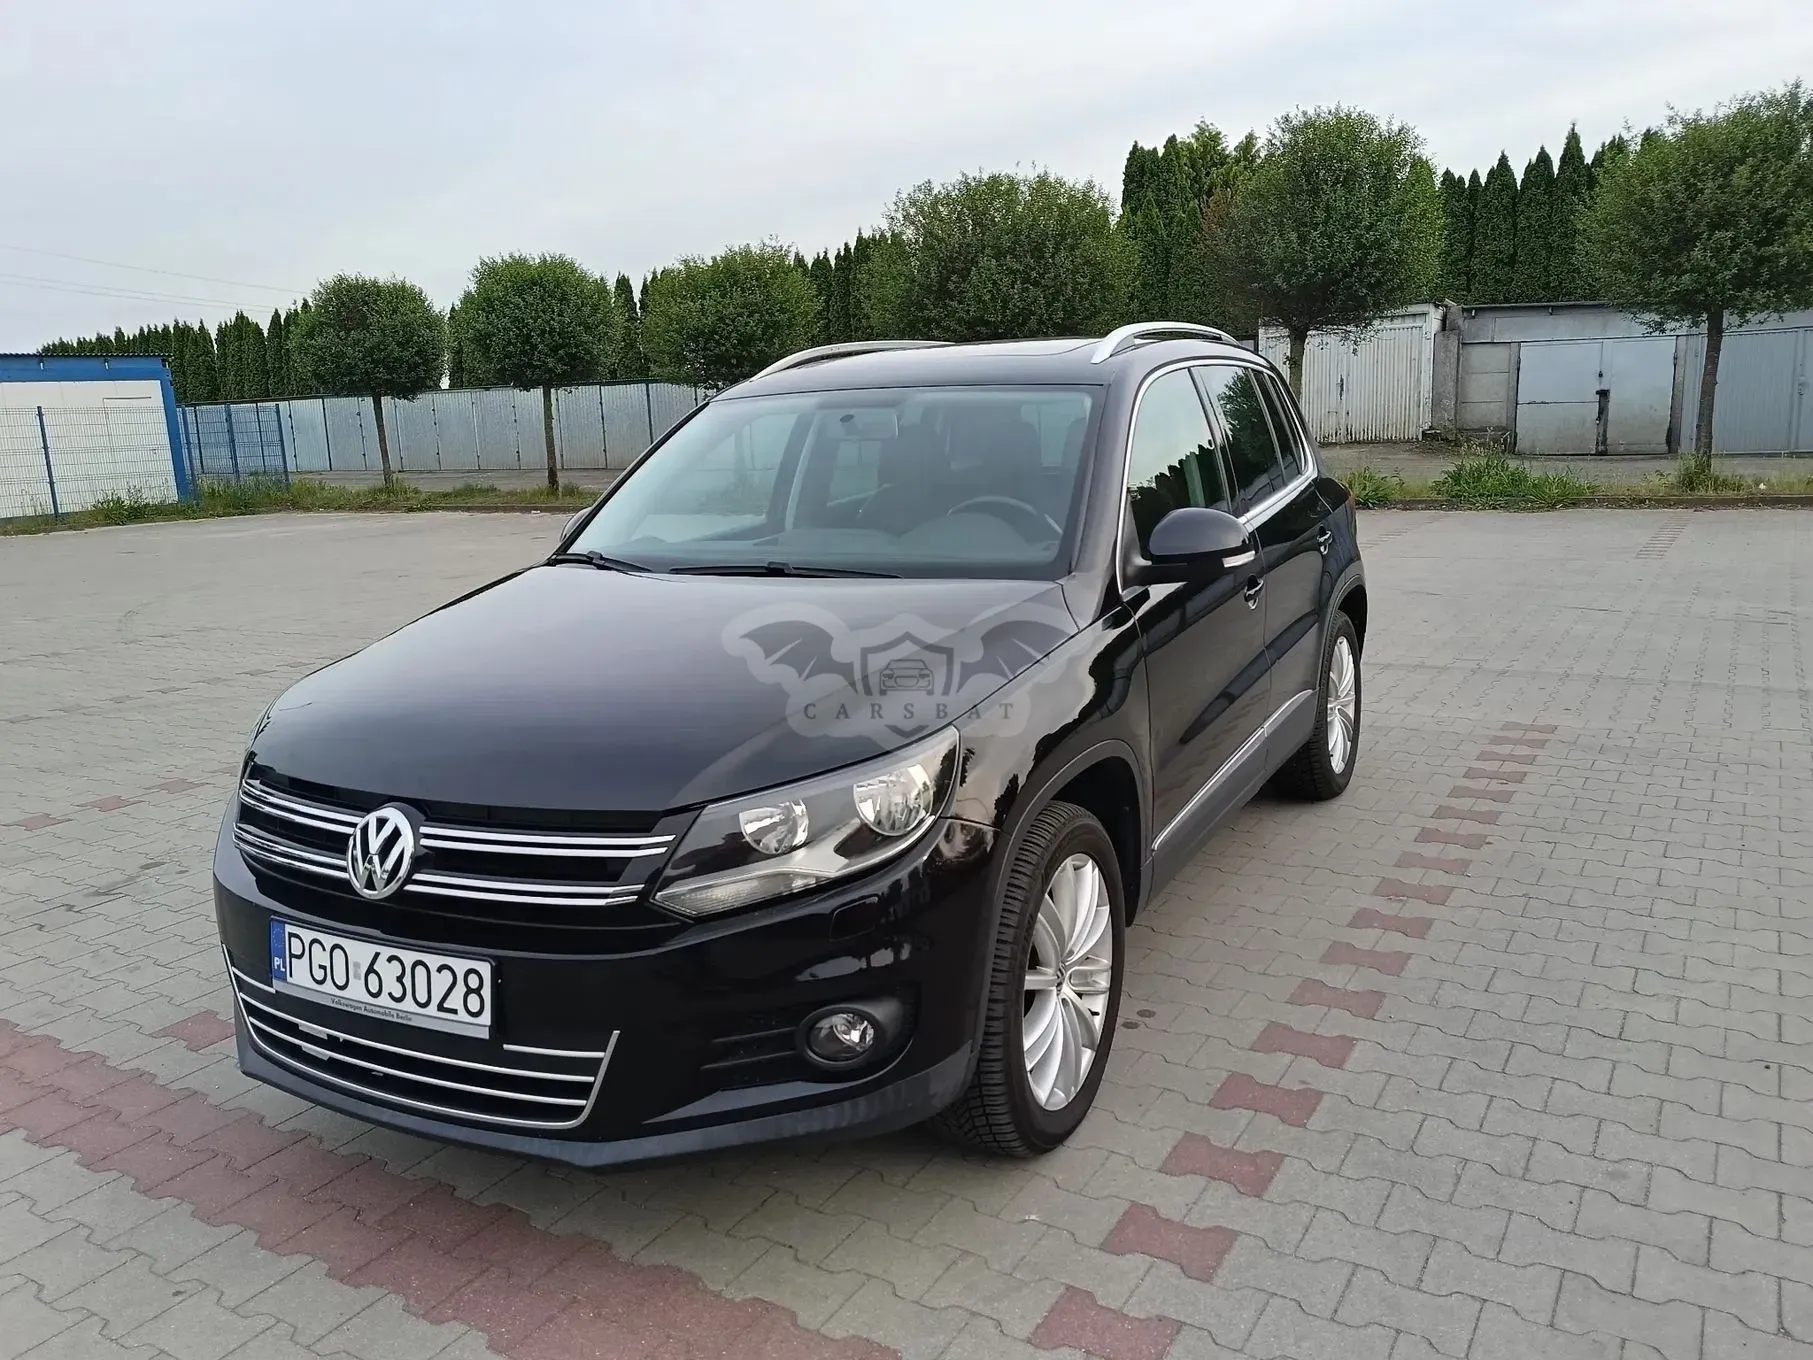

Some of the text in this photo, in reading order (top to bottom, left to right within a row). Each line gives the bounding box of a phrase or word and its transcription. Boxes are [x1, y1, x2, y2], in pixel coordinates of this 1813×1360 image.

[349, 810, 411, 896] VW
[273, 956, 286, 972] PL
[287, 931, 485, 1018] PGO 63028
[330, 997, 413, 1022] Volkswagen Automobile Berlin
